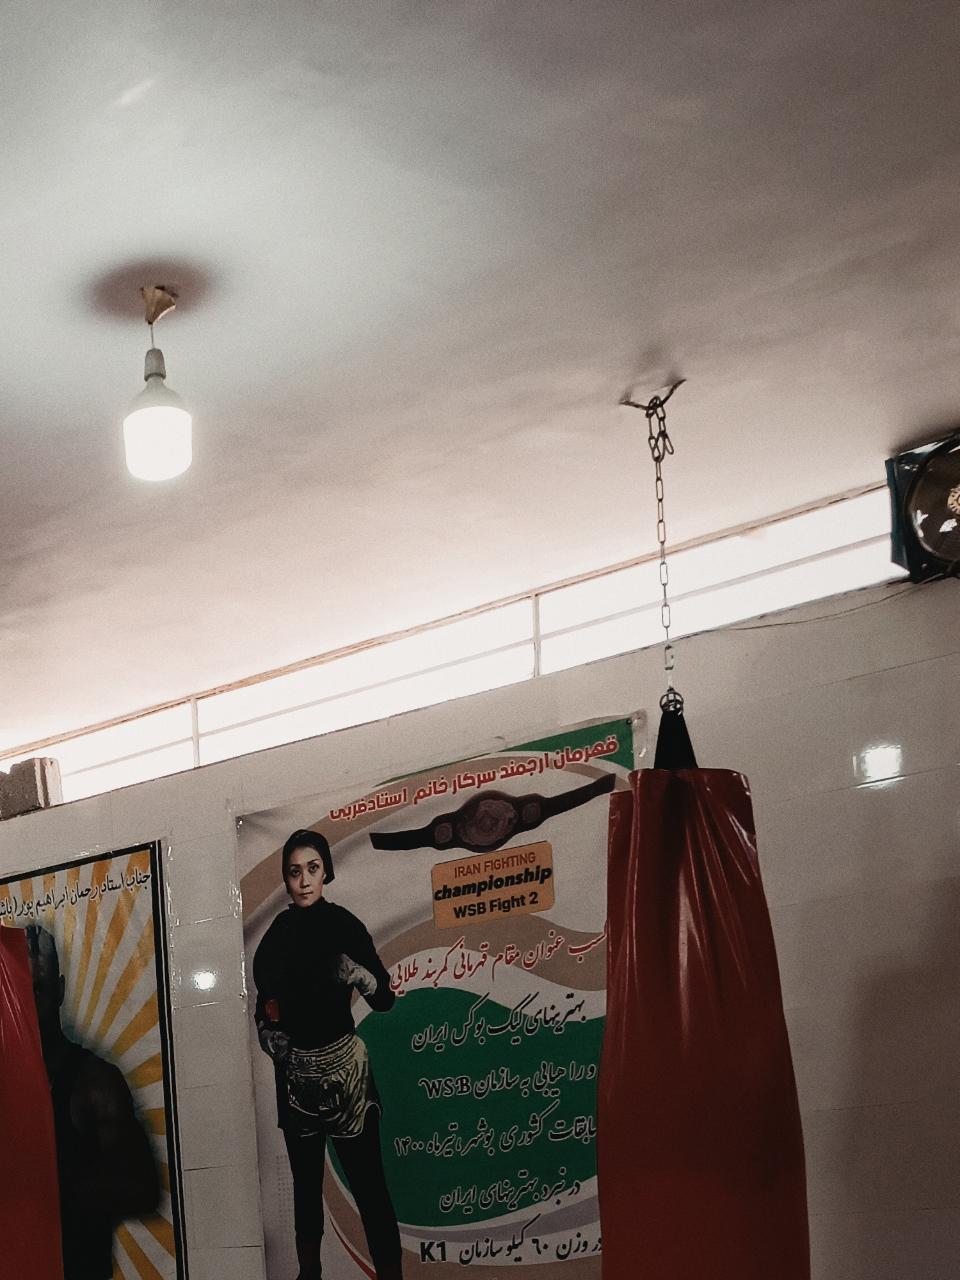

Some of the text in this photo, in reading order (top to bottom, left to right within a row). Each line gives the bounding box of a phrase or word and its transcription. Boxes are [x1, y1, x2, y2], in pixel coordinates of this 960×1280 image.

[500, 753, 550, 779] ارجمند
[554, 735, 618, 769] قهرمان
[414, 776, 448, 805] خانم
[452, 770, 496, 794] سرکار
[126, 867, 150, 891] جناب
[454, 852, 536, 878] IRAN FIGHTING
[70, 882, 99, 905] رحمان
[102, 872, 124, 892] استاد
[434, 865, 552, 902] championship
[36, 886, 68, 912] ابراهیم
[453, 891, 538, 919] WSB Fight 2
[422, 937, 464, 988] کمربند
[454, 942, 489, 980] قهرمانی
[491, 944, 520, 983] مقام
[522, 930, 565, 969] عنوان
[390, 957, 419, 996] طلایی
[450, 991, 490, 1044] بوکس
[486, 991, 540, 1044] کیک
[411, 1022, 449, 1052] ایران
[474, 1066, 519, 1099] سازمان
[586, 1063, 596, 1080] و
[418, 1075, 471, 1100] WSB
[520, 1077, 530, 1098] به
[500, 1098, 561, 1152] کشوری
[438, 1184, 477, 1215] ایران
[540, 1166, 568, 1206] نبرد
[568, 1179, 582, 1197] در
[420, 1240, 446, 1262] K1
[458, 1237, 503, 1266] سازمان
[505, 1212, 542, 1262] کیلو
[555, 1232, 588, 1260] وزن
